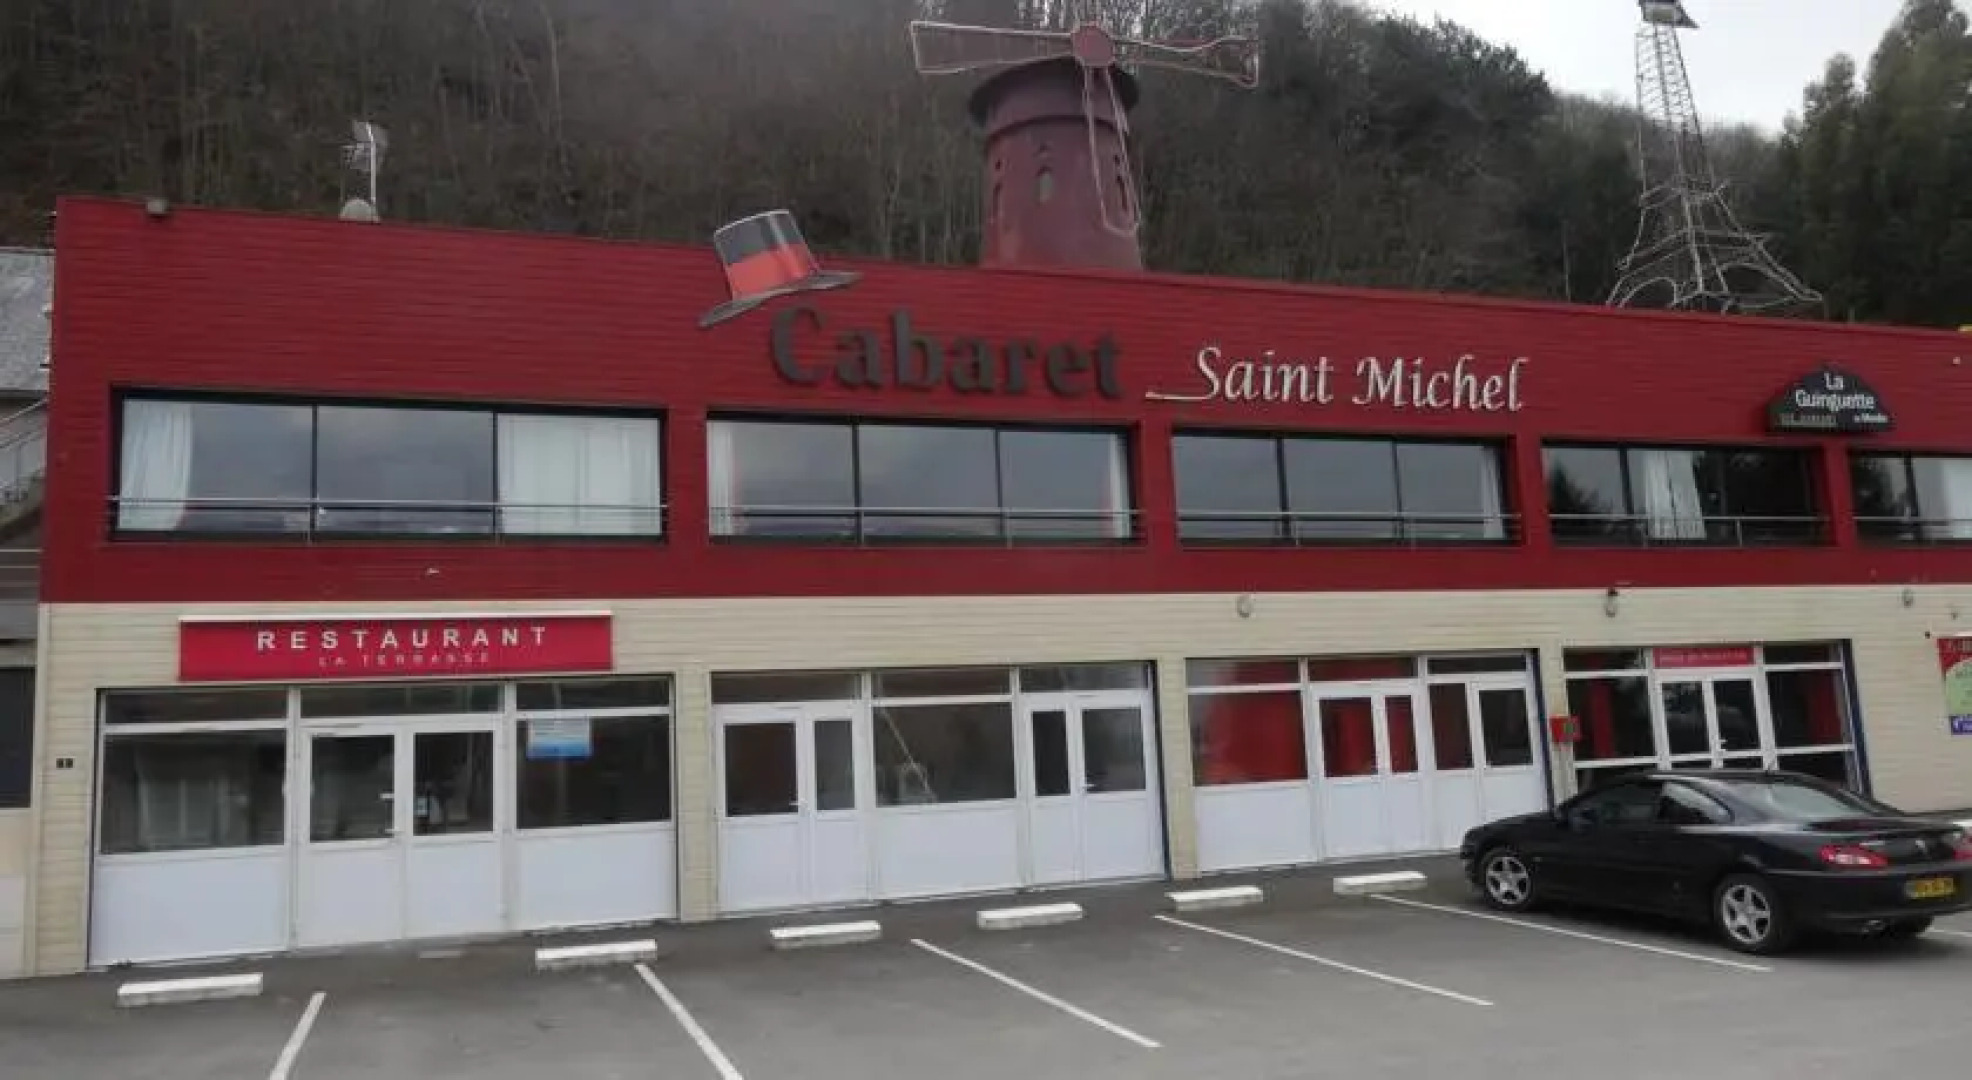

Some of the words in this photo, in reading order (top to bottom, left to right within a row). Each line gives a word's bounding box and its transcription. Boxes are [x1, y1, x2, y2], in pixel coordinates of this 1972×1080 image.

[769, 306, 1122, 398] Cabaret
[1146, 346, 1334, 404] Saint
[1352, 353, 1529, 412] Michel
[1824, 372, 1844, 390] La
[256, 626, 547, 651] RESTAURANT
